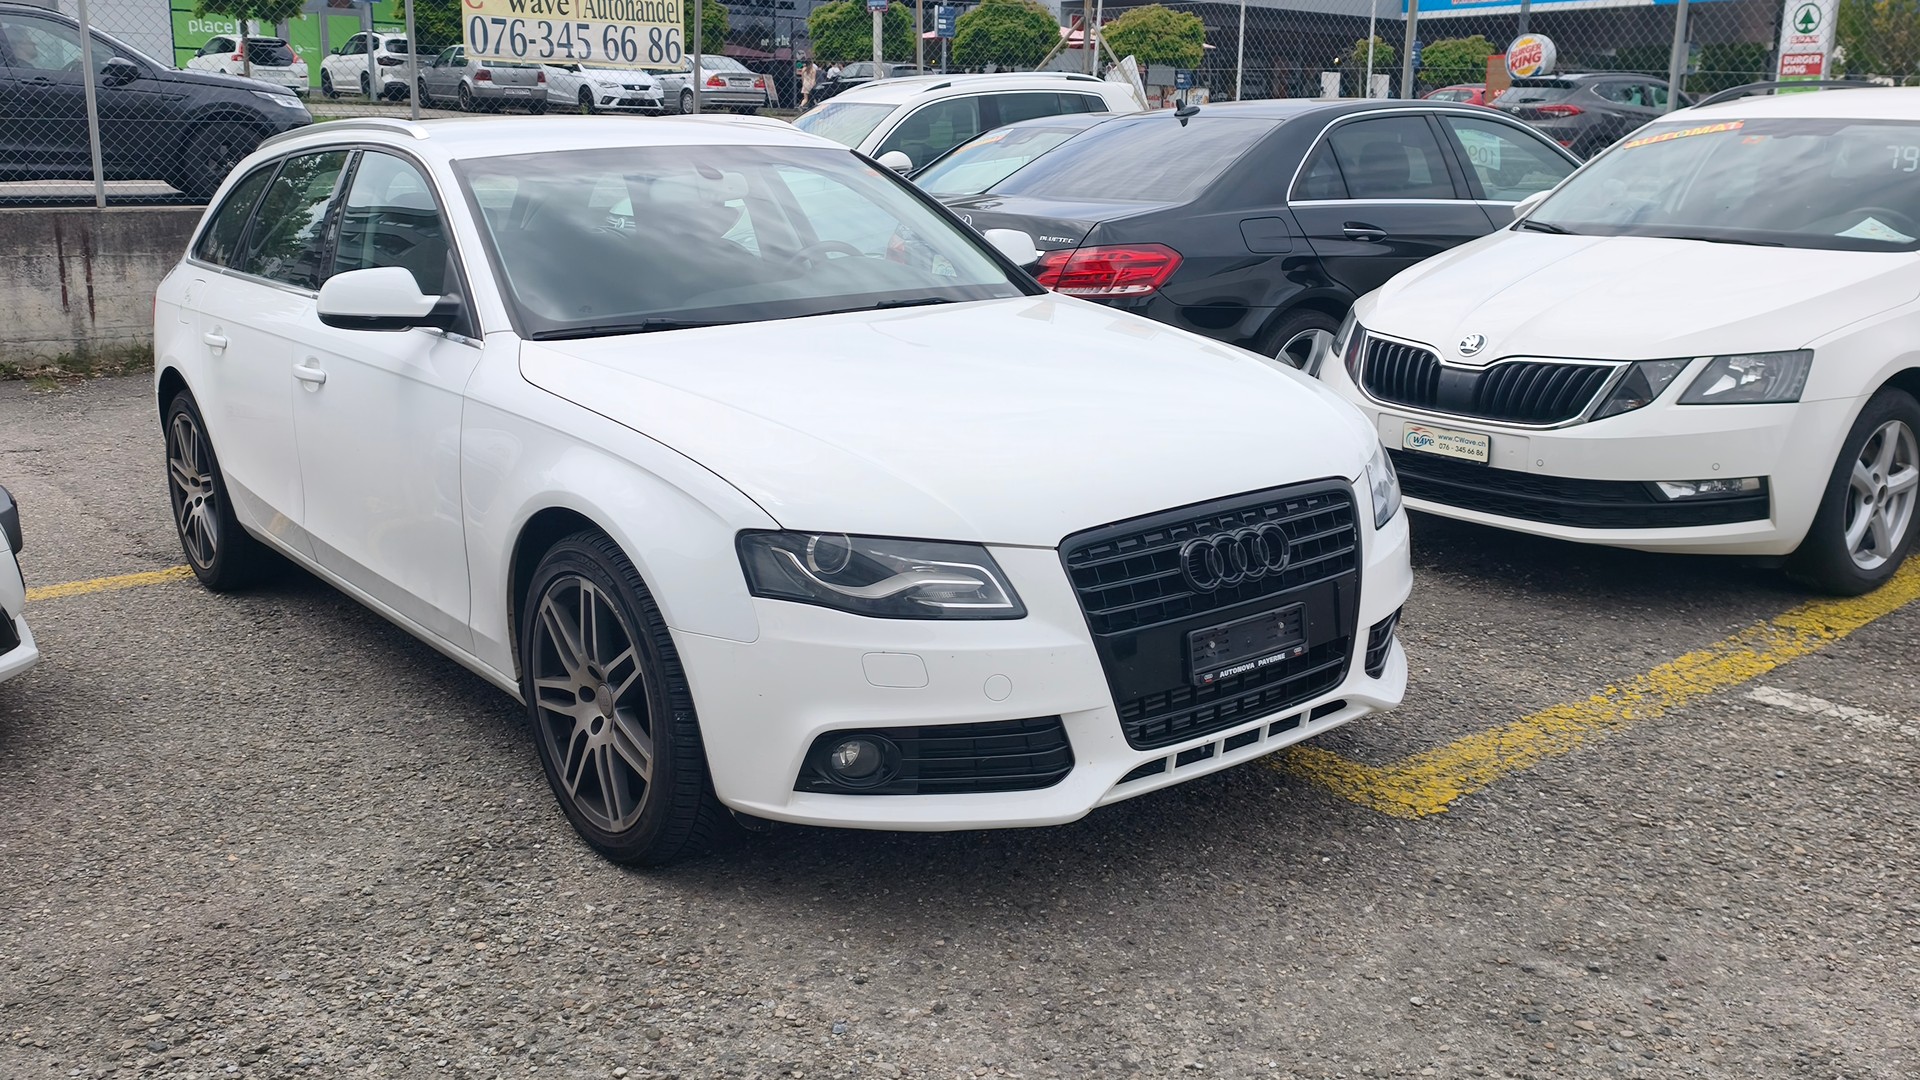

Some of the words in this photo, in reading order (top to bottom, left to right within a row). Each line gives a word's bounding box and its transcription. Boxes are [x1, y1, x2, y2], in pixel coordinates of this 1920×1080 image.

[583, 0, 681, 23] Autohandel
[188, 18, 233, 34] place
[470, 15, 592, 59] 076-345
[603, 24, 638, 62] 66
[648, 27, 681, 63] 86
[1510, 43, 1542, 60] BURGER
[1510, 52, 1542, 71] KING
[1783, 55, 1821, 65] BURGER
[1782, 65, 1807, 75] KING
[1438, 435, 1486, 448] www.CWave.ch
[1438, 443, 1450, 451] 076
[1455, 446, 1466, 454] 345
[1219, 662, 1255, 678] AUTONOVA
[1258, 653, 1286, 666] PAYERNE
